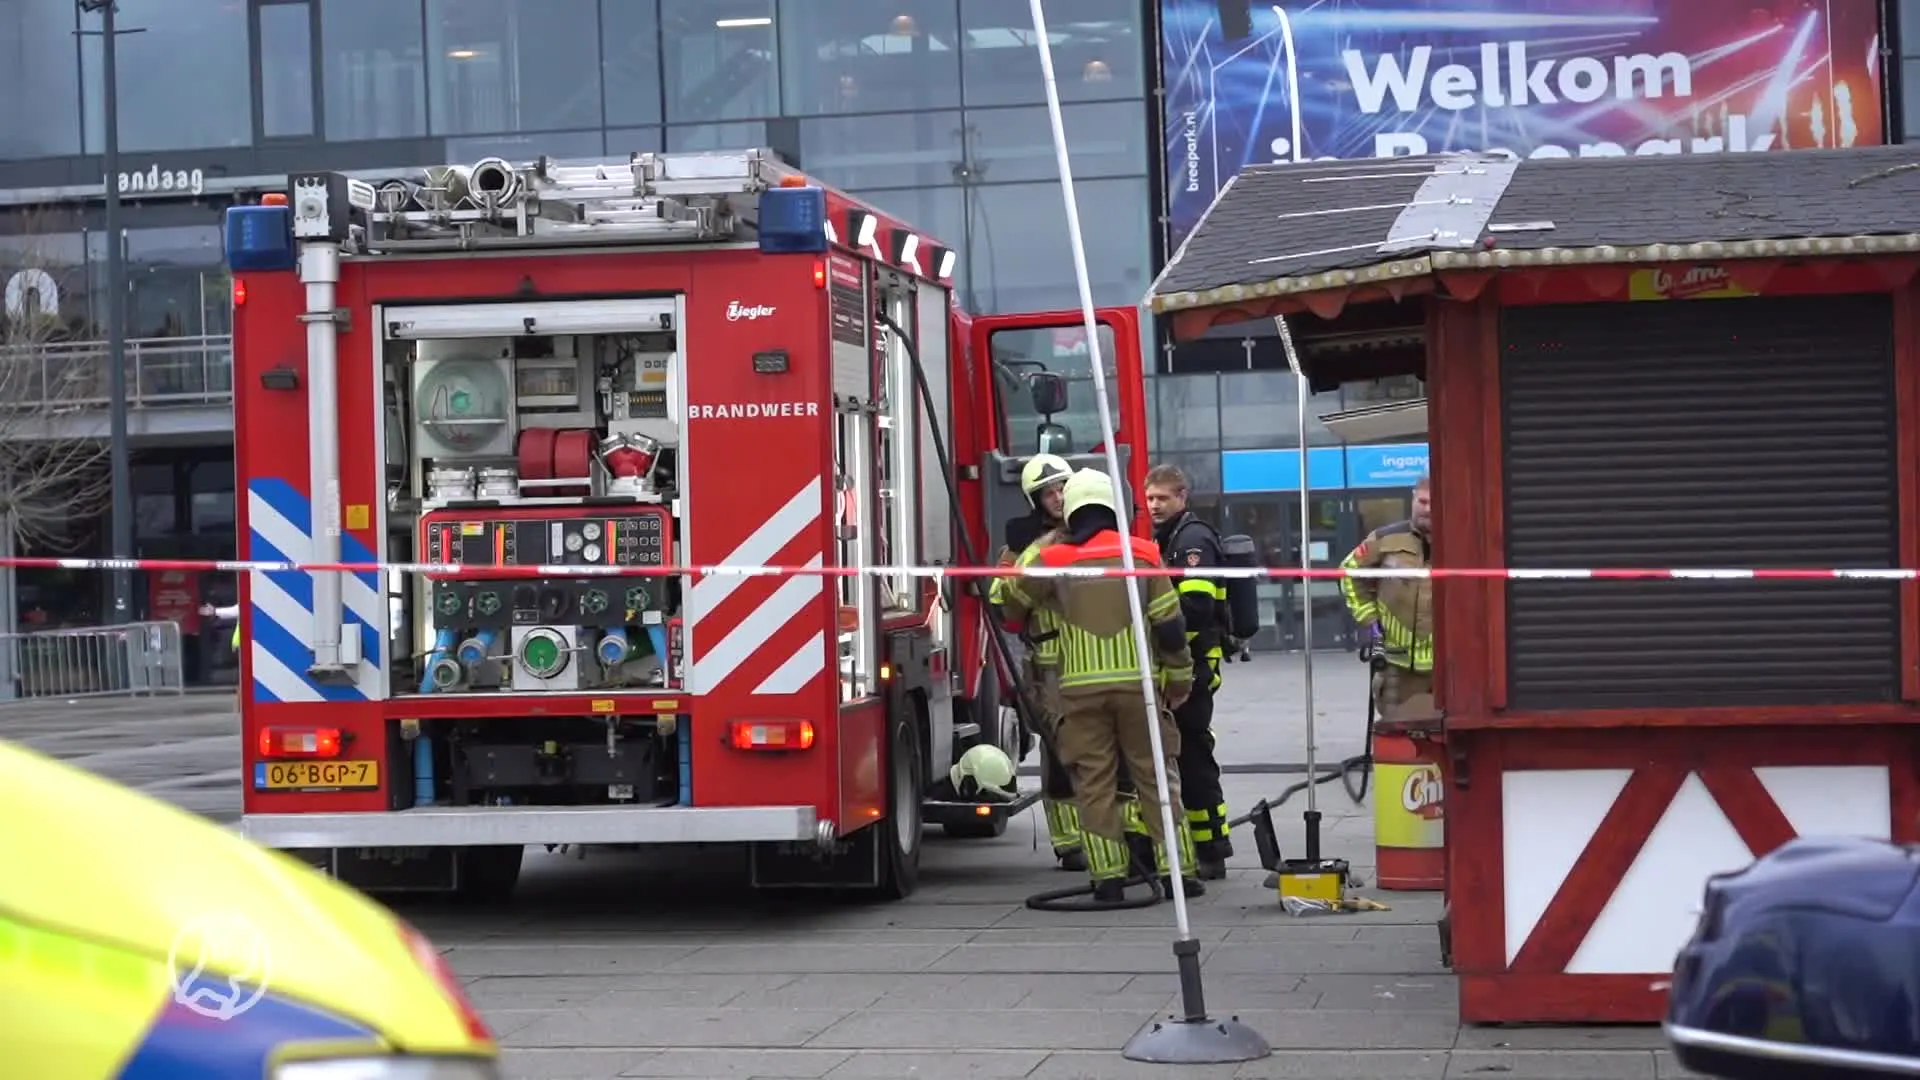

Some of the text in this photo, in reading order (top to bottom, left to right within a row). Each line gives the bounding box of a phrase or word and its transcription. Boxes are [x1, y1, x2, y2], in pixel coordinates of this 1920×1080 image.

[1343, 41, 1692, 113] Welkom
[1184, 112, 1200, 192] breepark.nl
[104, 163, 203, 196] andaag
[726, 301, 776, 321] Ziegler
[688, 402, 818, 419] BRANDWEER
[270, 764, 369, 784] 06-BGP-7
